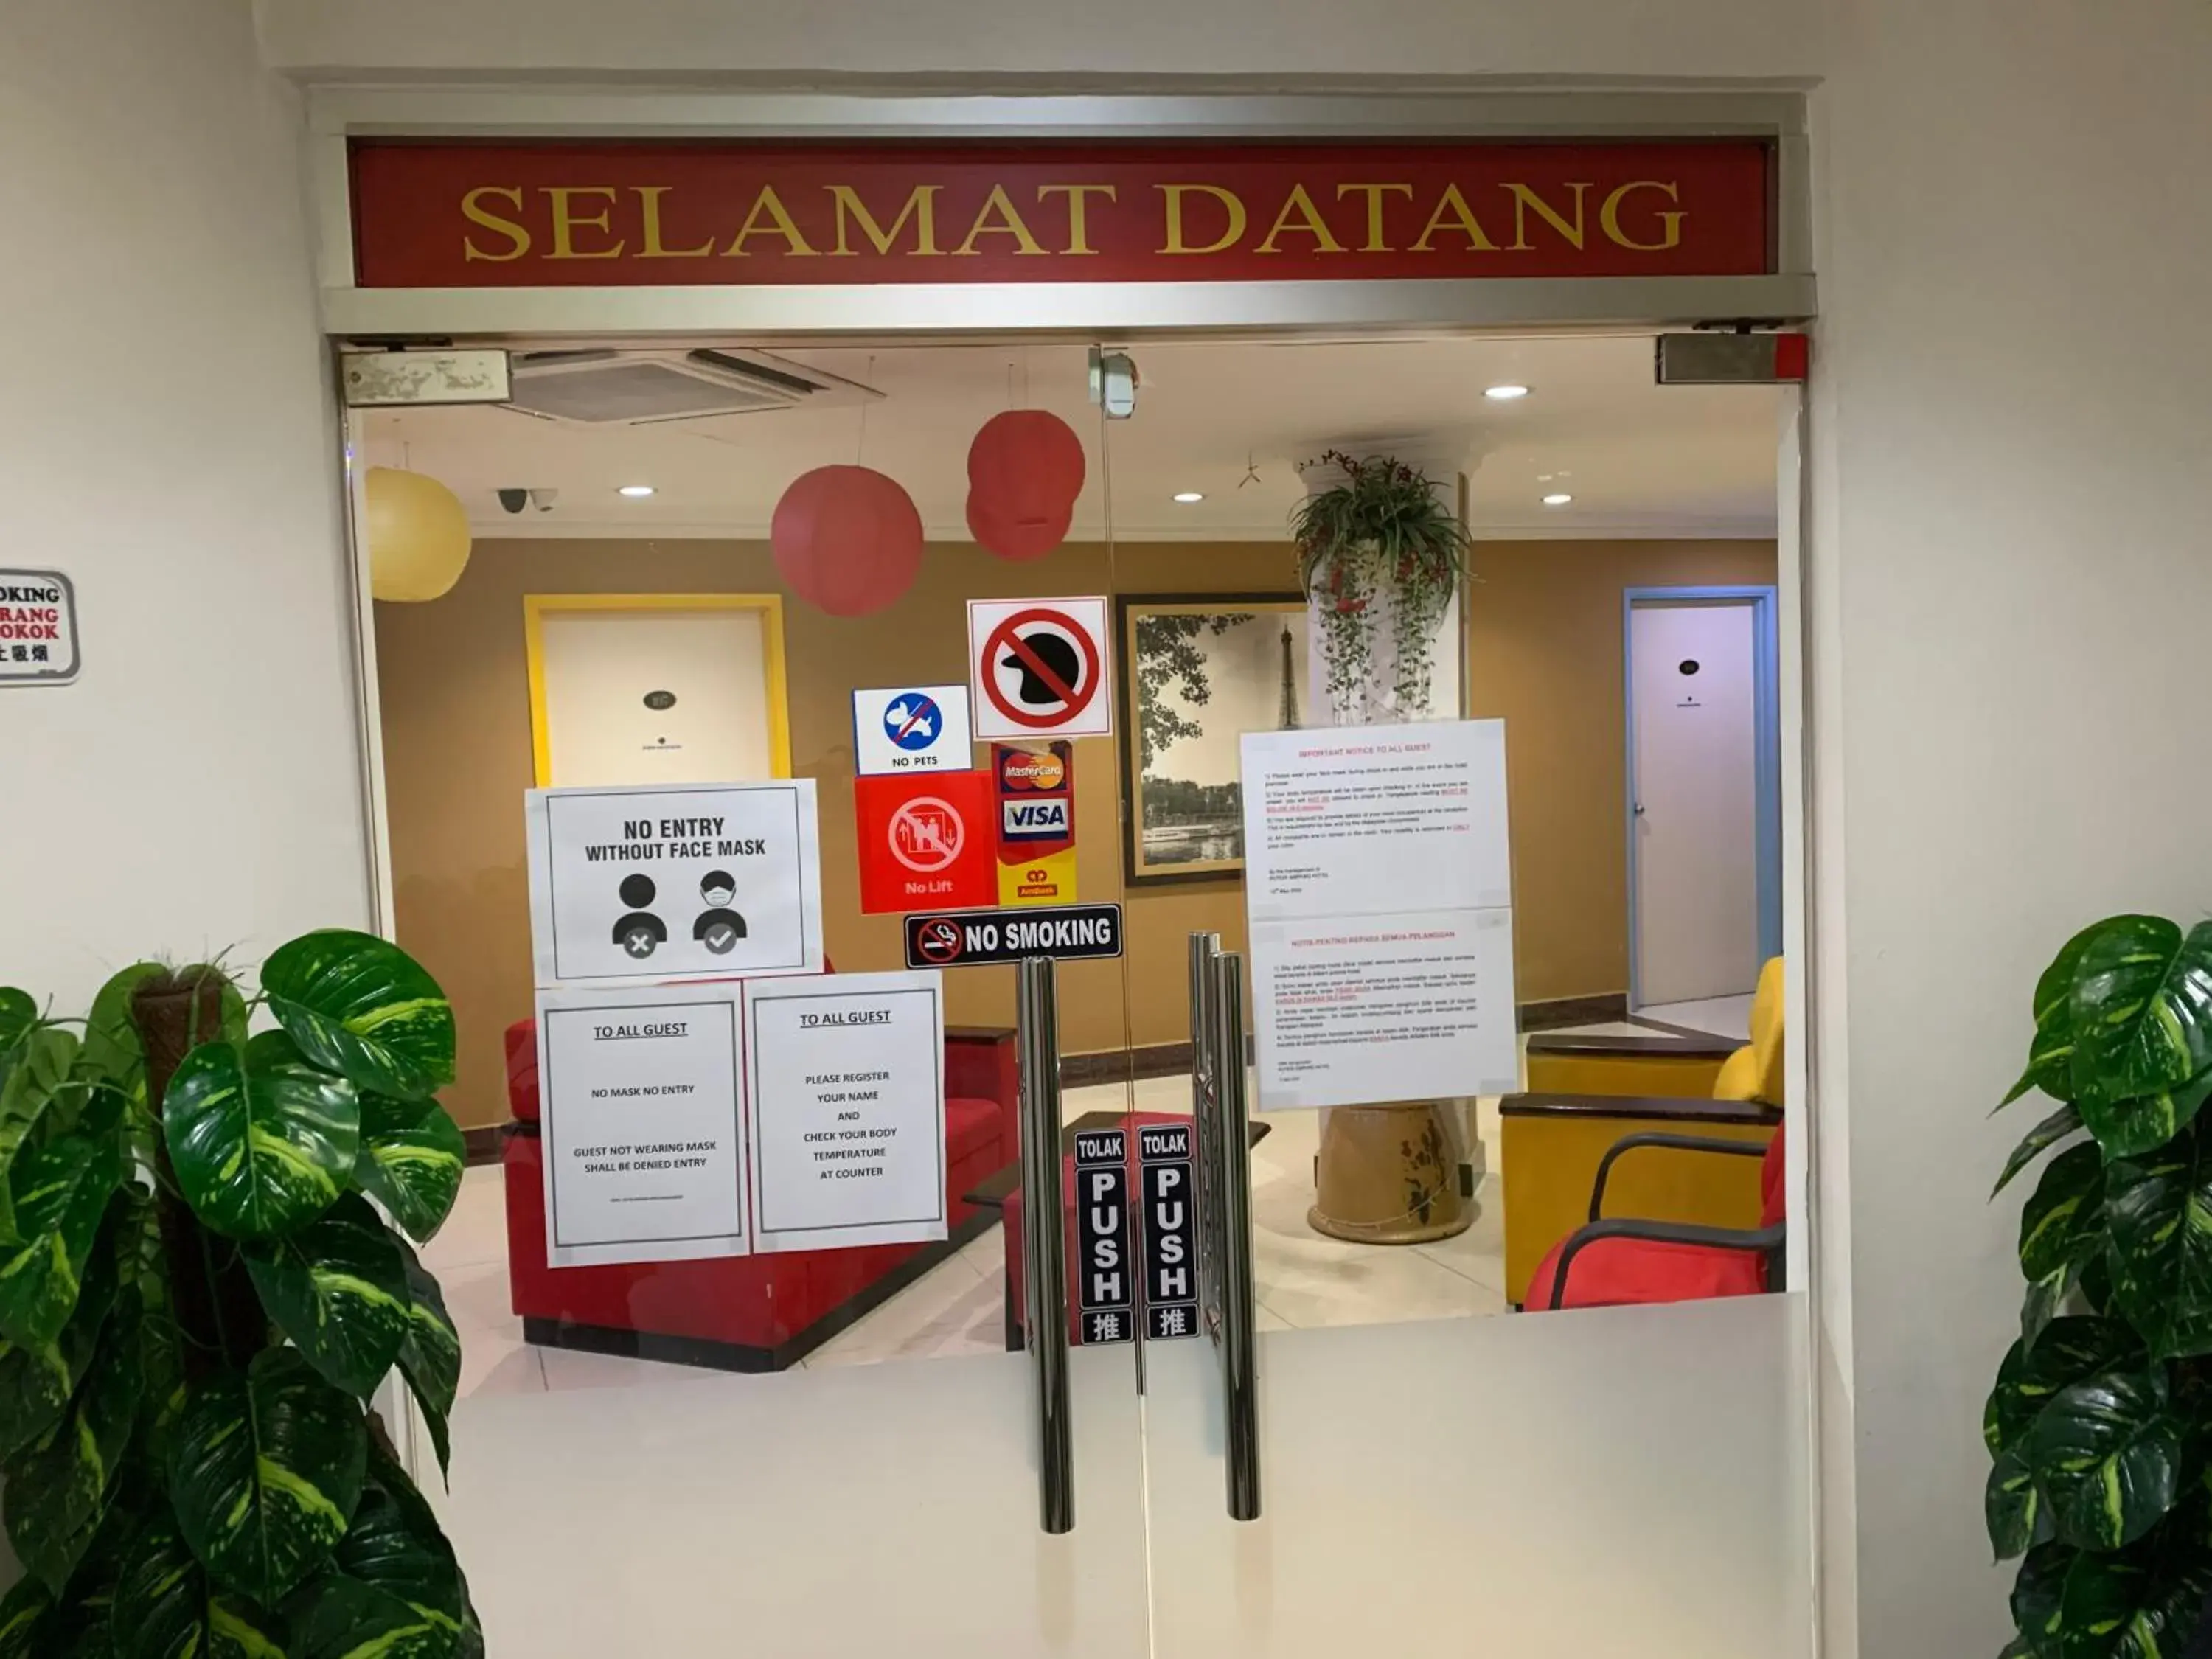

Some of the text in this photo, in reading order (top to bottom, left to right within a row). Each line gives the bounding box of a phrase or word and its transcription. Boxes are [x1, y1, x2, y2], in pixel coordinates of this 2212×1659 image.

[461, 181, 1688, 262] SELAMAT DATANG
[892, 756, 938, 767] NO PETS
[1005, 765, 1061, 778] MasterCard
[1009, 805, 1064, 826] VISA
[624, 817, 725, 840] NO ENTRY
[585, 839, 765, 861] WITHOUT FACE MASK
[905, 880, 953, 894] No Lift
[966, 917, 1111, 951] NO SMOKING
[801, 1011, 891, 1026] TO ALL GUEST
[594, 1023, 688, 1038] TO ALL GUEST
[806, 1071, 889, 1085] PLEASE REGISTER
[591, 1085, 695, 1098] NO MASK NO ENTRY
[818, 1091, 879, 1103] YOUR NAME
[838, 1111, 860, 1121] AND
[804, 1128, 897, 1142] CHECK YOUR BODY
[574, 1141, 716, 1158] GUEST NOT WEARING MASK
[1079, 1138, 1121, 1158] TOLAK
[1144, 1134, 1186, 1153] TOLAK
[813, 1148, 886, 1161] TEMPERATURE
[585, 1158, 706, 1173] SHALL BE DENIED ENTRY
[820, 1167, 883, 1180] AT COUNTER
[1091, 1173, 1121, 1301] PUSH
[1157, 1169, 1186, 1296] PUSH
[1093, 1314, 1120, 1341] 推
[1160, 1309, 1186, 1335] 推
